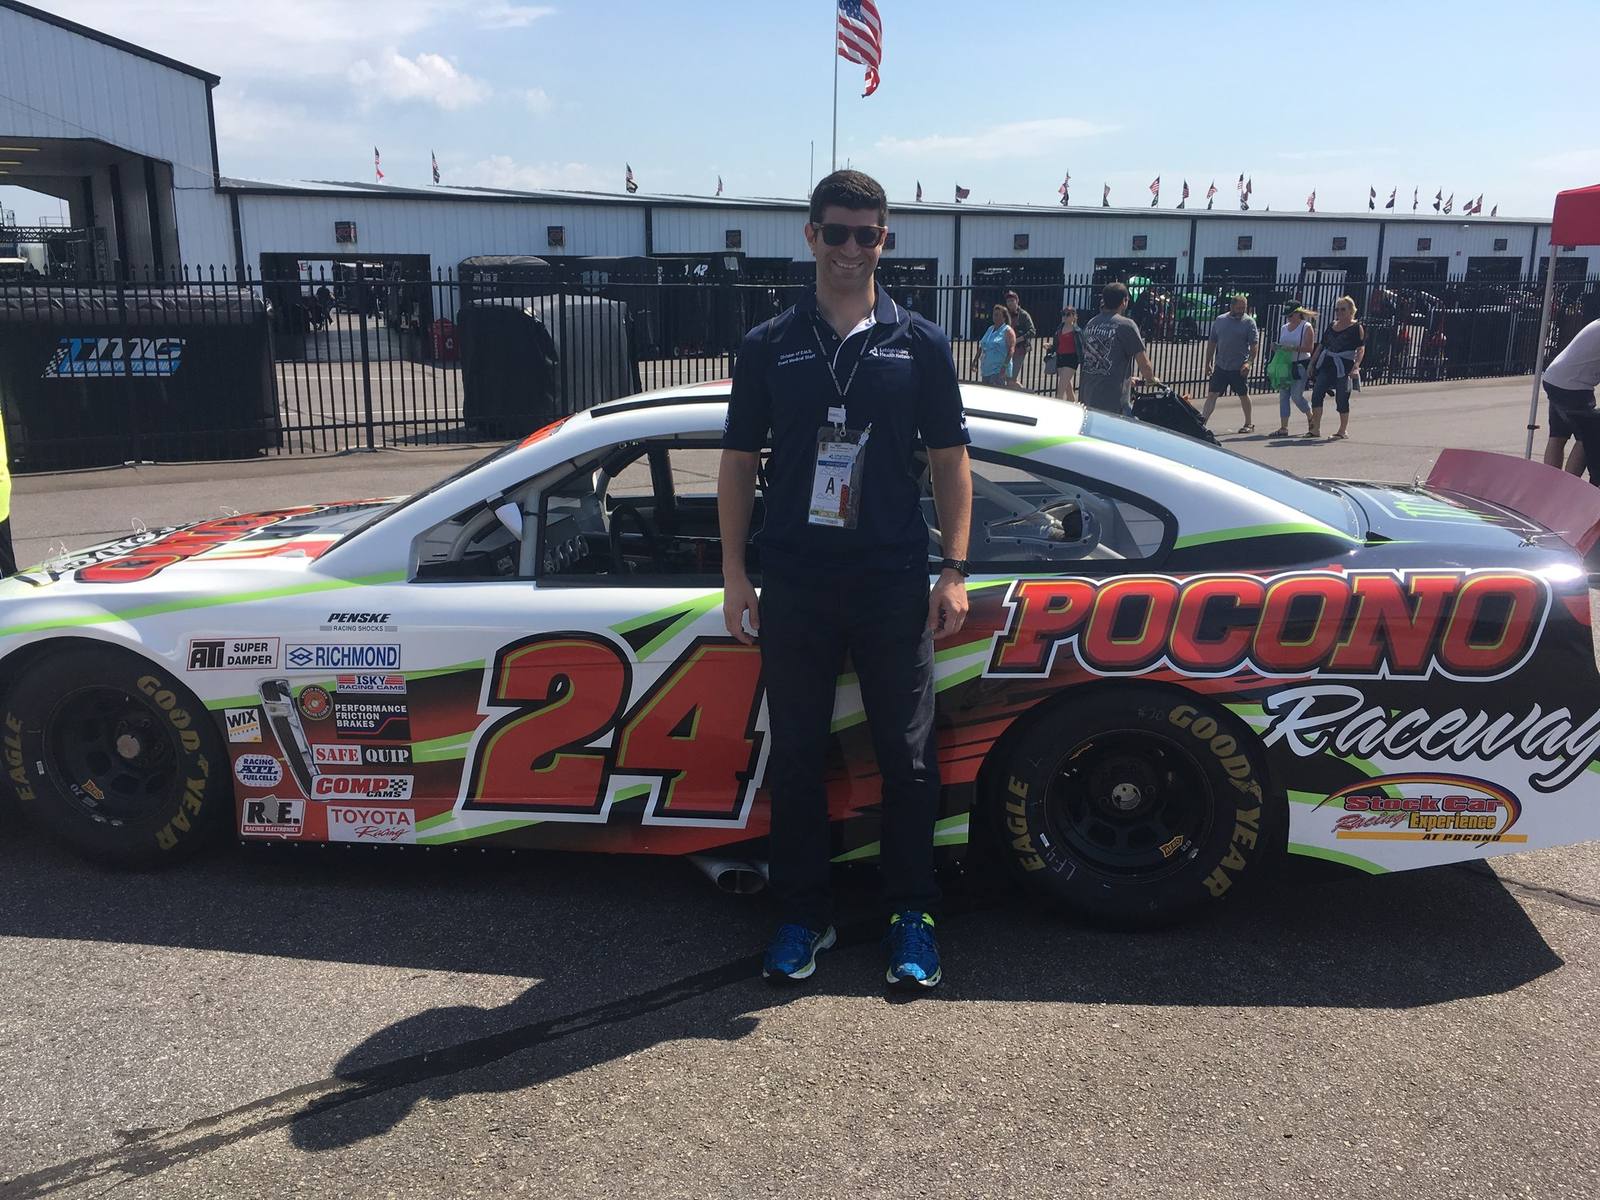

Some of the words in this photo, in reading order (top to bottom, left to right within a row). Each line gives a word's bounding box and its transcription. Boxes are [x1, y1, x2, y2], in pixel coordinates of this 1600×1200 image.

[825, 477, 835, 495] A
[327, 613, 392, 623] PENSKE
[986, 571, 1548, 677] POCONO
[190, 641, 225, 669] ATI
[233, 642, 269, 653] SUPER
[227, 655, 272, 665] DAMPER
[315, 646, 397, 667] RICHMOND
[356, 675, 386, 685] ISKY
[335, 704, 407, 713] PERFORMANCE
[336, 712, 380, 720] FRICTION
[227, 710, 257, 728] WIX
[337, 719, 375, 728] BRAKES
[458, 630, 767, 824] 24
[1260, 684, 1600, 789] Raceway
[4, 711, 37, 801] EAGLE
[243, 758, 274, 766] RACING
[316, 748, 359, 761] SAFE
[365, 749, 409, 763] QUIP
[316, 777, 389, 794] COMP
[366, 790, 402, 798] CAMS
[1344, 795, 1441, 812] Stock
[1441, 795, 1505, 812] Car
[330, 808, 411, 826] TOYOTA
[1006, 775, 1047, 871] EAGLE
[1331, 811, 1407, 833] Racing
[1408, 811, 1498, 832] Experience
[354, 825, 411, 841] Racing
[1422, 833, 1438, 841] AT
[1442, 834, 1501, 842] POCONO
